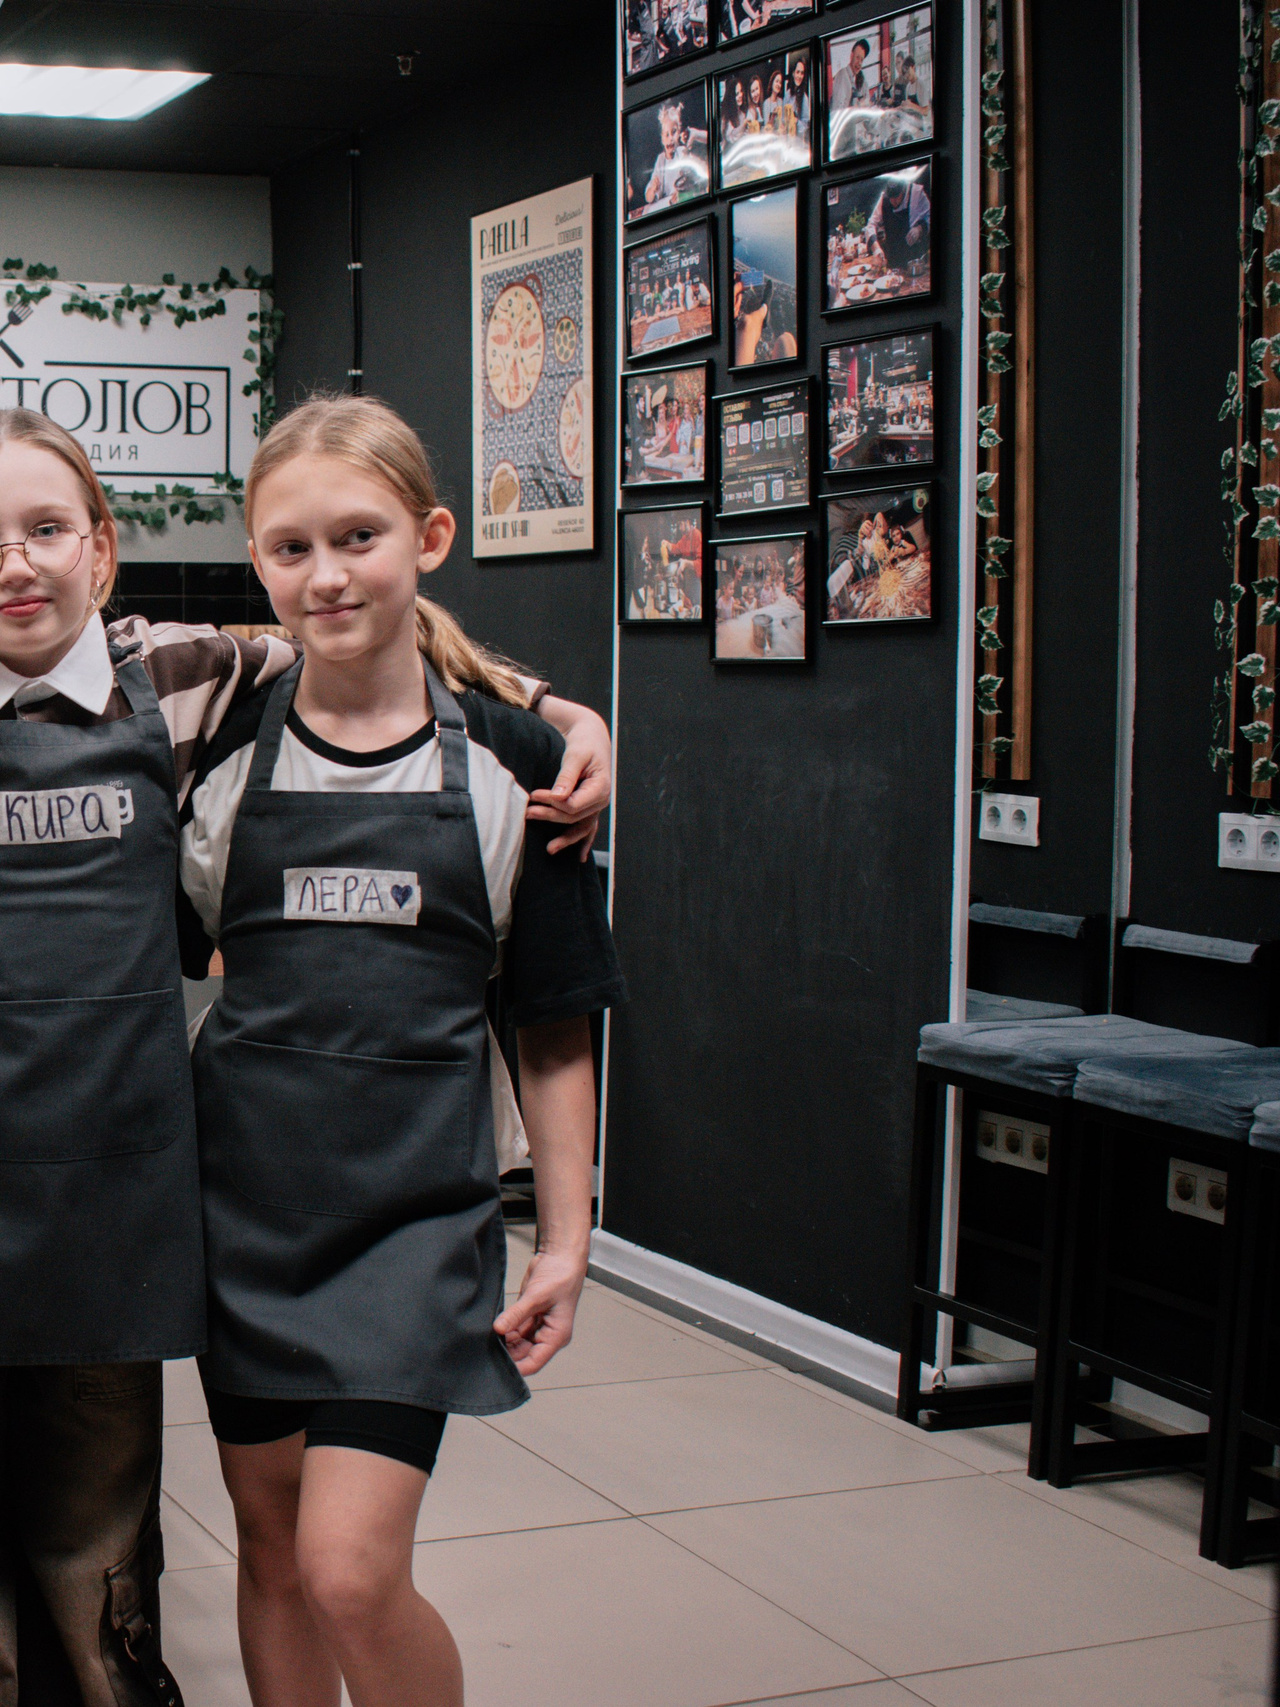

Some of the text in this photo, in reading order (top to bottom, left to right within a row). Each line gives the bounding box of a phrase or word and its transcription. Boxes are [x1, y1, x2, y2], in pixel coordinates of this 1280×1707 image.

[480, 215, 528, 260] PAELLA
[89, 443, 138, 463] ДИЯ
[298, 875, 384, 913] ЛЕРА
